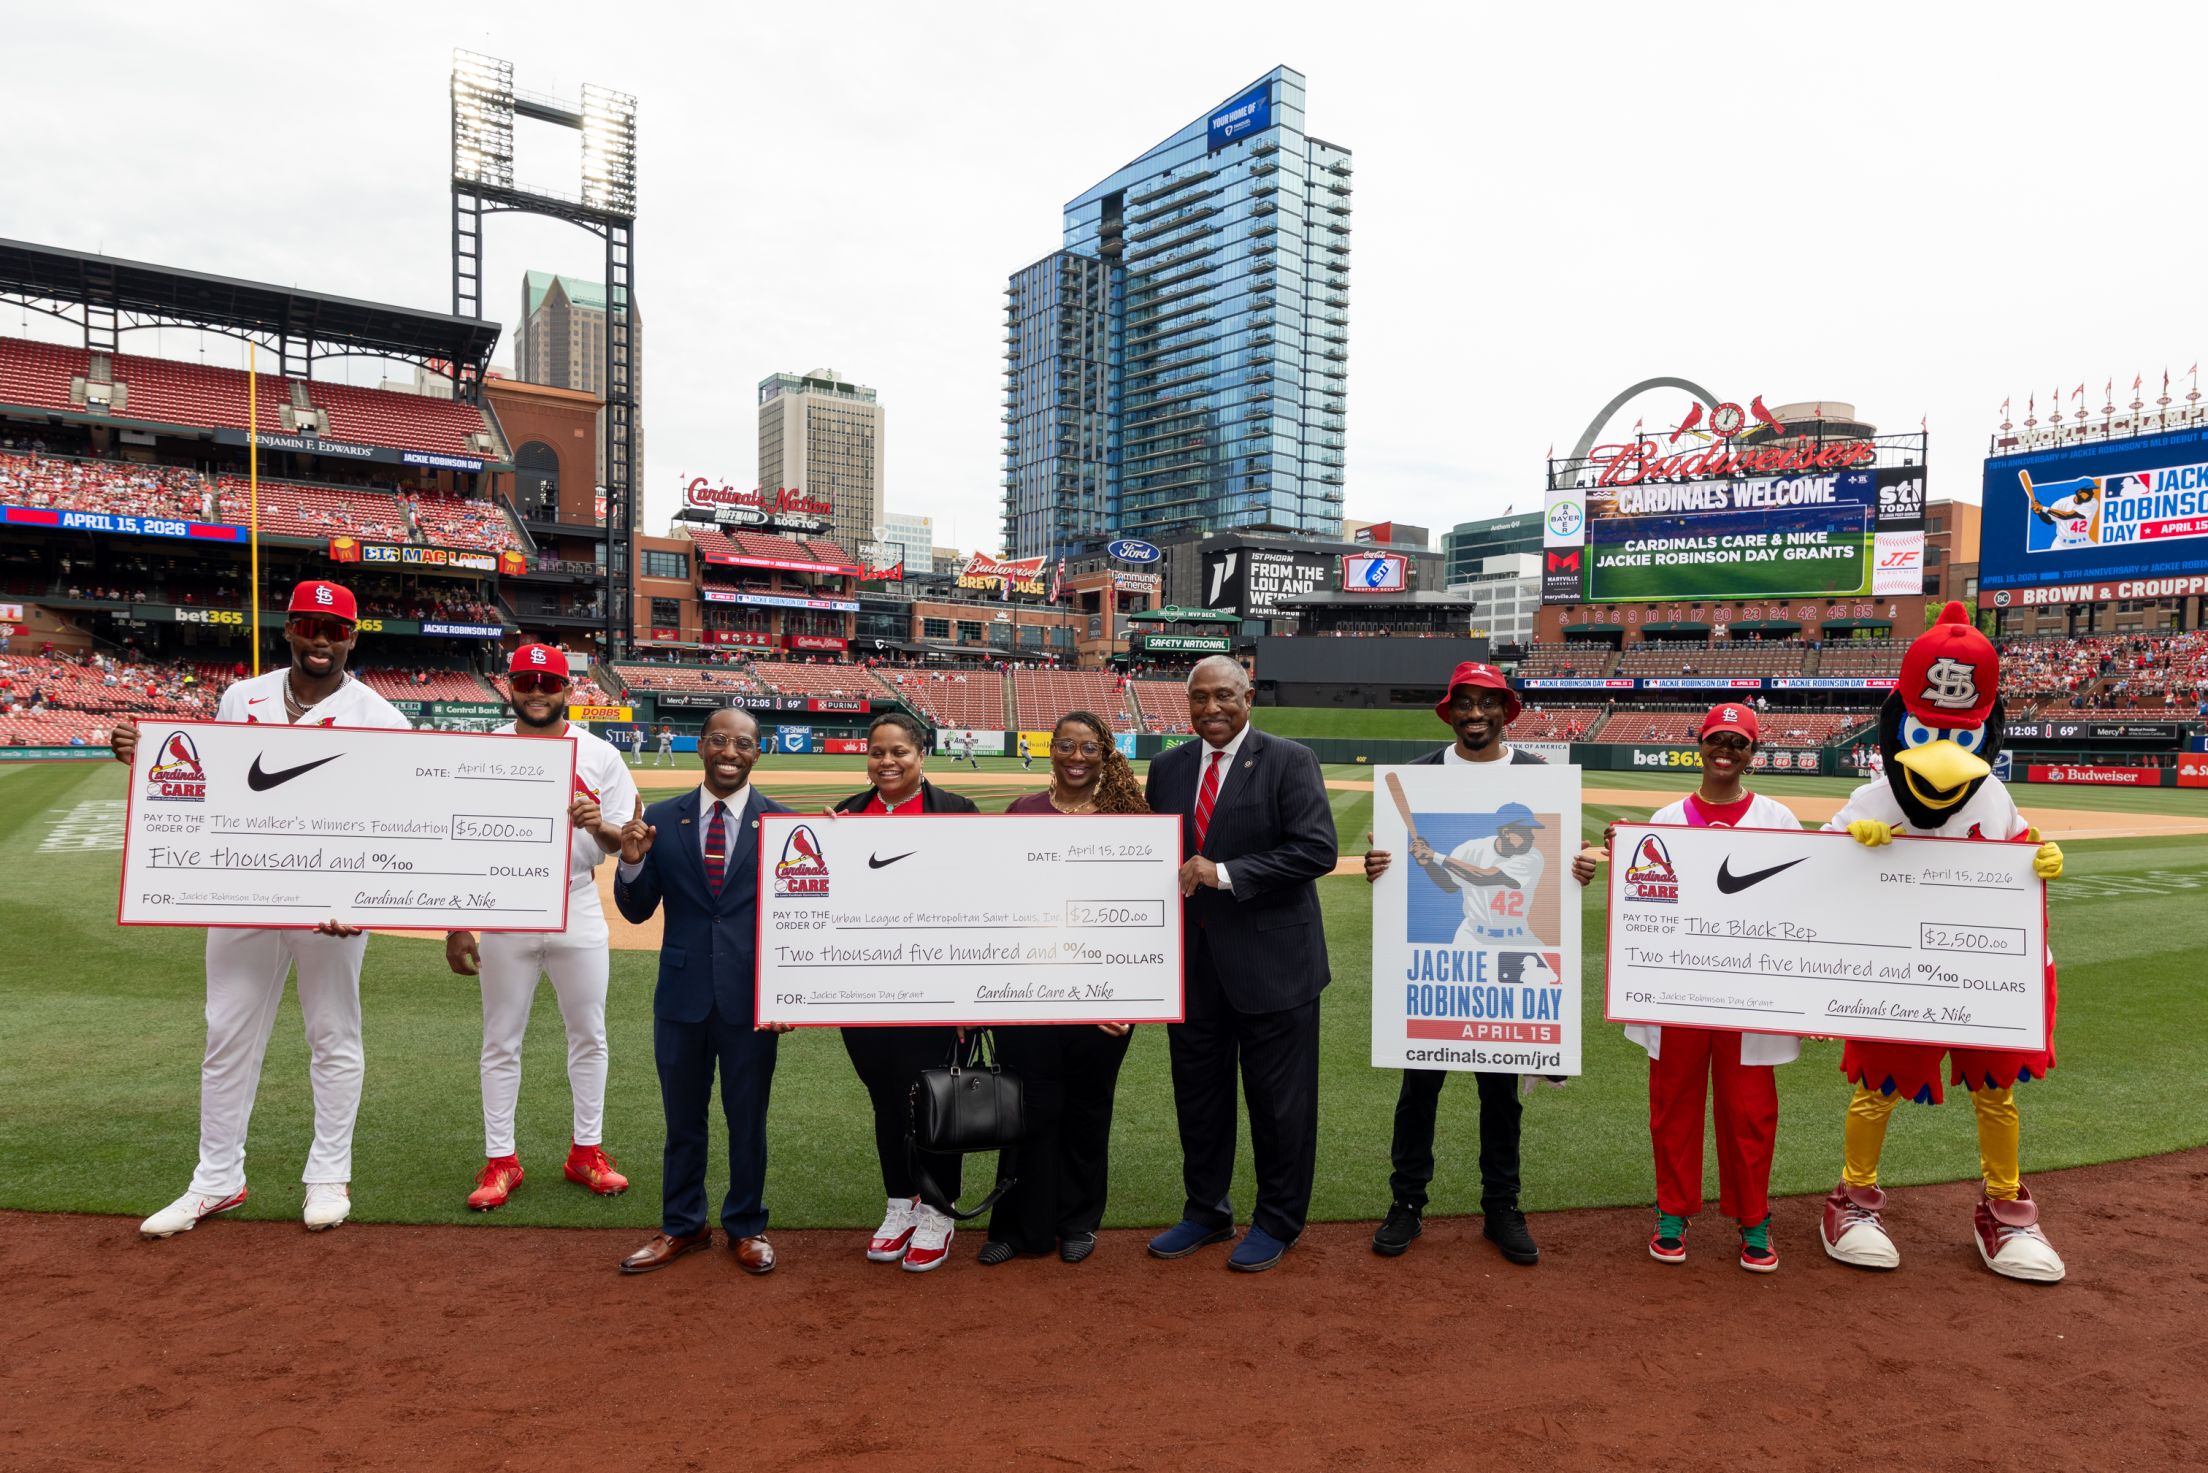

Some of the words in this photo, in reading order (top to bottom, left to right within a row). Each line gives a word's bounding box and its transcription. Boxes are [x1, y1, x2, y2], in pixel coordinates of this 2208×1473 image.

[1213, 114, 1229, 130] YOUR
[1229, 106, 1247, 122] HOME
[1248, 102, 1256, 114] OF
[2017, 423, 2103, 447] WORLD
[306, 440, 315, 450] F.
[319, 441, 371, 456] EDWARDS
[403, 453, 428, 464] JACKIE
[429, 456, 466, 468] ROBINSON
[467, 459, 482, 470] DAY
[1589, 435, 1876, 487] Budweiser
[688, 477, 766, 508] Cardinals
[767, 487, 832, 515] Nation
[1619, 484, 1728, 513] CARDINALS
[1733, 478, 1836, 508] WELCOME
[1879, 479, 1922, 504] stl
[714, 509, 759, 522] HOFFMANN
[1880, 503, 1921, 513] TODAY
[63, 512, 114, 530] APRIL
[117, 517, 140, 533] 15,
[144, 519, 186, 536] 2026
[774, 517, 819, 529] ROOFTOP
[2070, 520, 2087, 533] 42
[2103, 523, 2137, 543] DAY
[2161, 522, 2193, 534] APRIL
[1120, 541, 1151, 559] Ford
[1625, 536, 1717, 552] CARDINALS
[1721, 533, 1767, 549] CARE
[1771, 533, 1782, 545] &
[1787, 531, 1828, 545] NIKE
[363, 546, 400, 562] BIG
[403, 547, 446, 565] MAC
[448, 551, 497, 571] LAND
[1597, 554, 1651, 568] JACKIE
[1655, 550, 1741, 565] ROBINSON
[1745, 549, 1777, 562] DAY
[1783, 545, 1854, 560] GRANTS
[1250, 562, 1292, 578] FROM
[1296, 566, 1324, 581] THE
[959, 576, 997, 590] BREW
[1250, 577, 1278, 592] LOU
[1282, 580, 1313, 594] AND
[2023, 585, 2094, 604] BROWN
[2100, 587, 2112, 599] &
[175, 608, 243, 625] bet365
[1714, 607, 1732, 621] 20
[1743, 607, 1761, 621] 23
[1770, 607, 1788, 621] 24
[1798, 606, 1817, 620] 42
[1827, 605, 1847, 619] 45
[1854, 605, 1873, 619] 85
[423, 623, 448, 633] JACKIE
[449, 625, 486, 635] ROBINSON
[487, 626, 502, 636] DAY
[1150, 639, 1181, 647] SAFETY
[1183, 640, 1225, 649] NATIONAL
[478, 706, 500, 714] Bank
[582, 708, 620, 716] DOBBS
[747, 699, 770, 708] 12:05
[828, 702, 858, 710] PURINA
[780, 726, 809, 734] CarShield
[2009, 726, 2038, 736] 12:05
[2060, 726, 2078, 736] 69°
[148, 766, 206, 783] Cardinals
[415, 768, 450, 778] DATE:
[458, 762, 485, 775] April
[489, 764, 505, 775] 15,
[510, 765, 544, 777] 2026
[2067, 769, 2139, 782] Budweiser
[161, 783, 206, 797] CARE
[144, 814, 163, 823] PAY
[167, 815, 181, 823] TO
[185, 815, 205, 823] THE
[211, 815, 240, 829] The
[246, 815, 306, 830] Walker's
[312, 818, 365, 832] Winners
[371, 819, 448, 835] Foundation
[146, 824, 182, 833] ORDER
[186, 825, 201, 833] OF
[456, 820, 532, 838] $5,000.00
[149, 846, 200, 867] Five
[210, 847, 322, 869] thousand
[330, 852, 365, 870] and
[1027, 852, 1061, 862] DATE:
[1067, 844, 1095, 857] April
[1098, 845, 1115, 857] 15,
[1119, 845, 1153, 856] 2026
[490, 867, 549, 877] DOLLARS
[775, 861, 829, 879] Cardinals
[1625, 868, 1678, 884] Cardinals
[1880, 873, 1915, 884] DATE:
[1922, 869, 1951, 880] April
[1955, 871, 1972, 882] 15,
[1977, 872, 2012, 883] 2026
[787, 879, 829, 892] CARE
[1637, 884, 1678, 898] CARE
[143, 894, 174, 905] FOR:
[354, 889, 413, 906] Cardinals
[416, 893, 446, 906] Care
[449, 895, 462, 908] &
[467, 892, 496, 908] Nike
[1490, 890, 1524, 917] 42
[832, 914, 861, 924] Urban
[865, 914, 900, 928] League
[903, 912, 914, 923] of
[917, 913, 980, 924] Metropolitan
[983, 912, 1009, 923] Saint
[1070, 908, 1148, 924] $2,500.00
[1684, 918, 1720, 935] The
[1726, 919, 1776, 937] Black
[1778, 922, 1817, 943] Rep
[1925, 928, 2008, 949] $2,500.00
[775, 946, 814, 961] Two
[820, 944, 902, 961] thousand
[909, 943, 944, 962] five
[950, 943, 1020, 960] hundred
[1026, 942, 1057, 960] and
[1106, 954, 1164, 965] DOLLARS
[1407, 949, 1487, 983] JACKIE
[1625, 947, 1663, 963] Two
[1669, 949, 1752, 969] thousand
[1758, 954, 1793, 972] five
[1801, 957, 1872, 977] hundred
[1879, 962, 1911, 979] and
[976, 982, 1033, 999] Cardinals
[1037, 984, 1064, 998] Care
[1068, 986, 1080, 1000] &
[1085, 981, 1114, 999] Nike
[1963, 979, 2026, 993] DOLLARS
[776, 994, 806, 1005] FOR:
[1406, 983, 1514, 1019] ROBINSON
[1522, 987, 1563, 1021] DAY
[1626, 992, 1656, 1003] FOR:
[1827, 998, 1886, 1016] Cardinals
[1890, 1003, 1919, 1018] Care
[1923, 1007, 1936, 1022] &
[1941, 1006, 1971, 1023] Nike
[1462, 1024, 1523, 1040] APRIL
[1530, 1027, 1551, 1041] 15
[1406, 1047, 1560, 1068] cardinals.com/jrd
